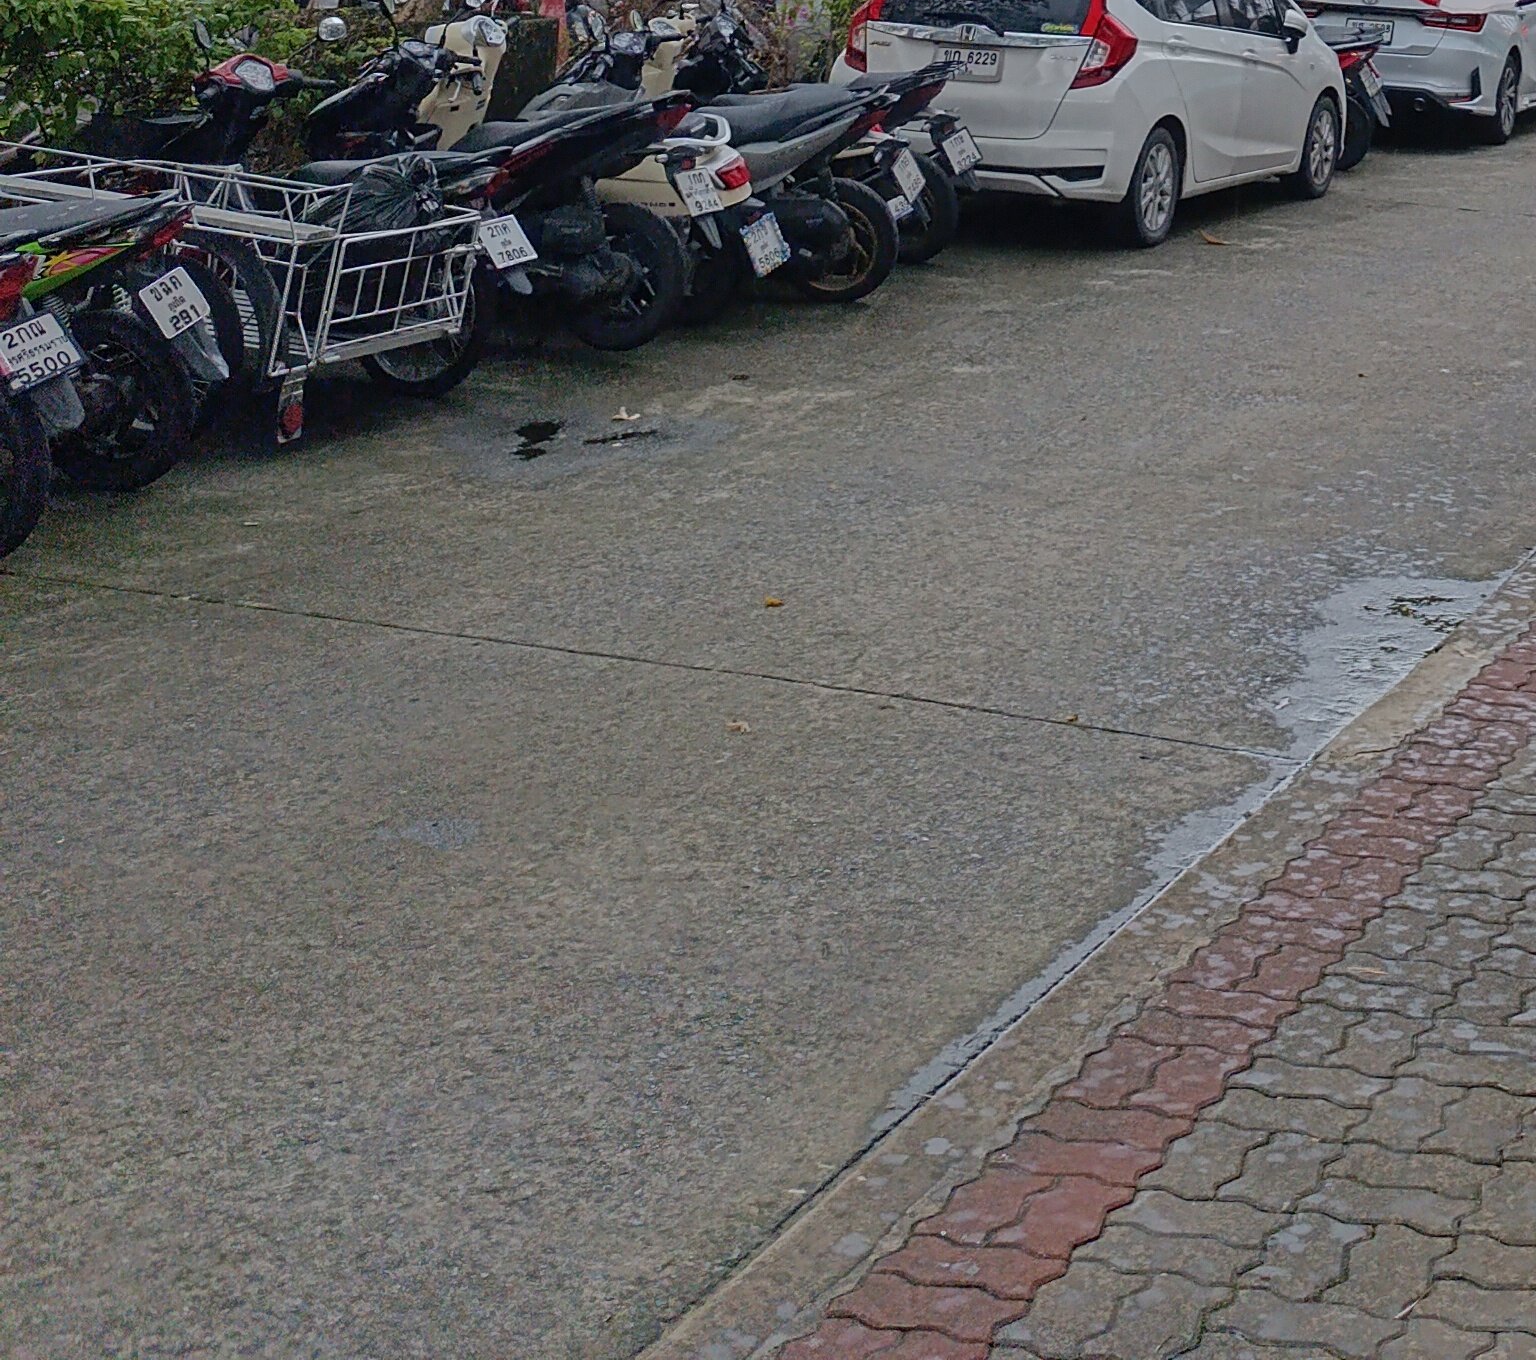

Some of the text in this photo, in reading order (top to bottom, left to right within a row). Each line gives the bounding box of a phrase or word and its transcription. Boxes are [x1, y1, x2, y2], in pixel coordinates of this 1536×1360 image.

[967, 51, 997, 65] 6229
[497, 246, 528, 263] 7806
[168, 304, 202, 332] 291
[16, 350, 72, 385] 5500
